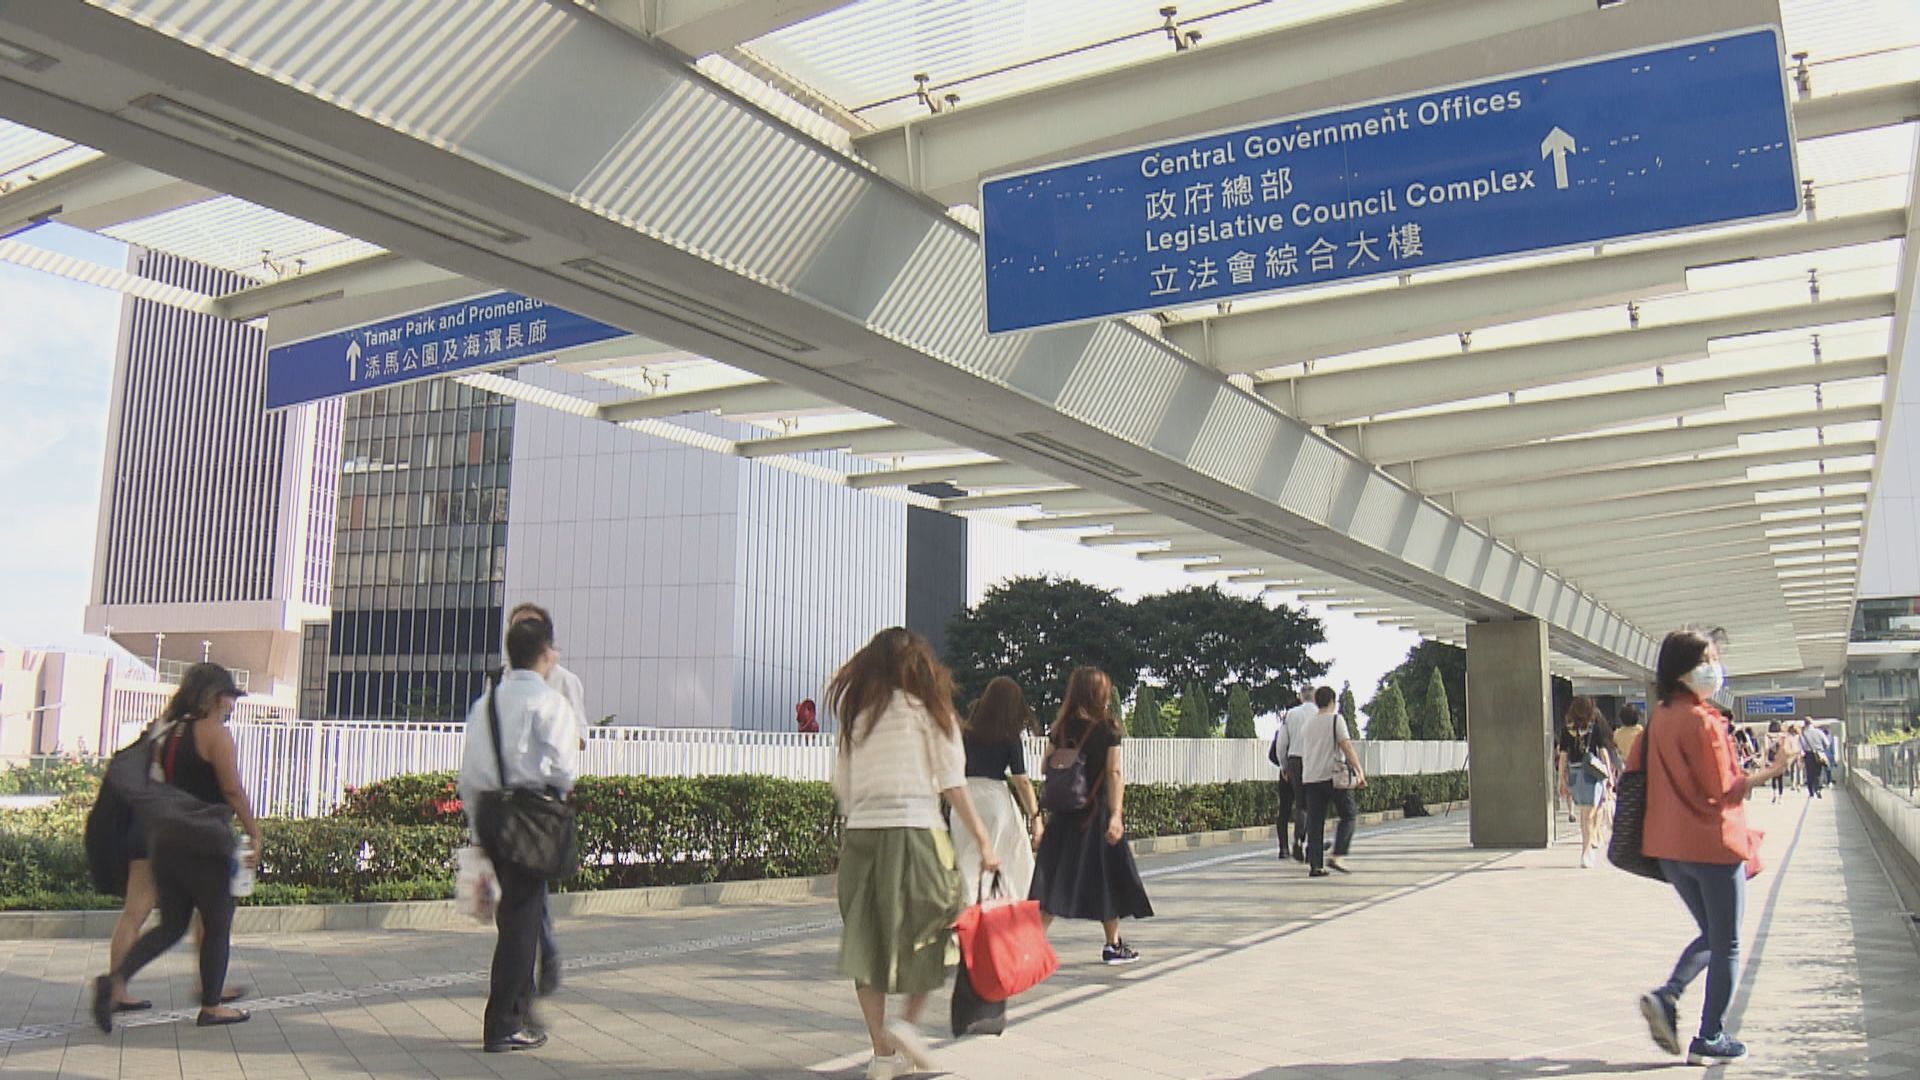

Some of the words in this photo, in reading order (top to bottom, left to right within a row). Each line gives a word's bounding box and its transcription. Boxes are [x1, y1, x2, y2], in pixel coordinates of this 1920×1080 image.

[1140, 141, 1235, 178] Central
[1244, 108, 1409, 158] Government
[1417, 90, 1522, 126] Offices
[1144, 166, 1293, 222] 政府總部
[1145, 213, 1284, 253] Legislative
[1292, 188, 1396, 226] Council
[1406, 169, 1535, 207] Complex
[1149, 221, 1424, 297] 立法會綜合大樓
[364, 326, 402, 347] Tamar
[405, 319, 436, 338] Park
[439, 308, 465, 330] and
